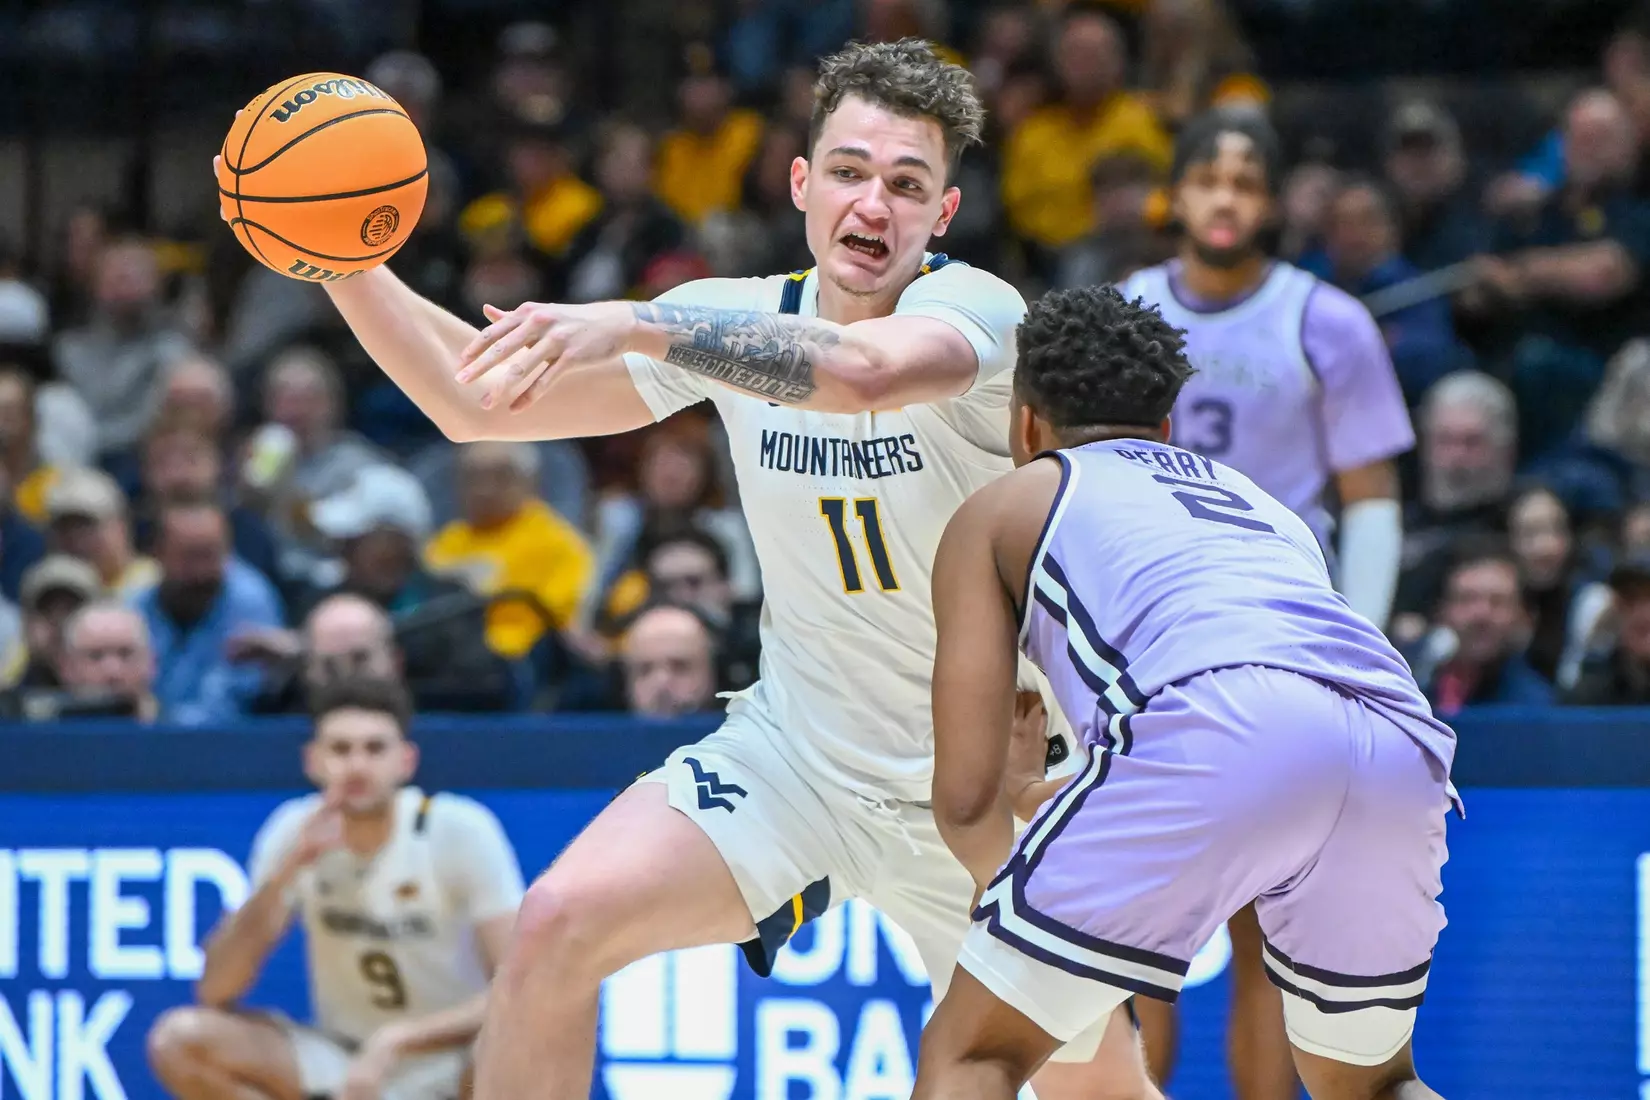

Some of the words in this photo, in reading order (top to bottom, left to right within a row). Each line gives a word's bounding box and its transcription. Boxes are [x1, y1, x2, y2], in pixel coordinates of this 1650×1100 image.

[760, 429, 923, 480] MOUNTANEERS
[1152, 474, 1277, 534] 2
[819, 496, 901, 594] 11
[359, 950, 407, 1011] 9
